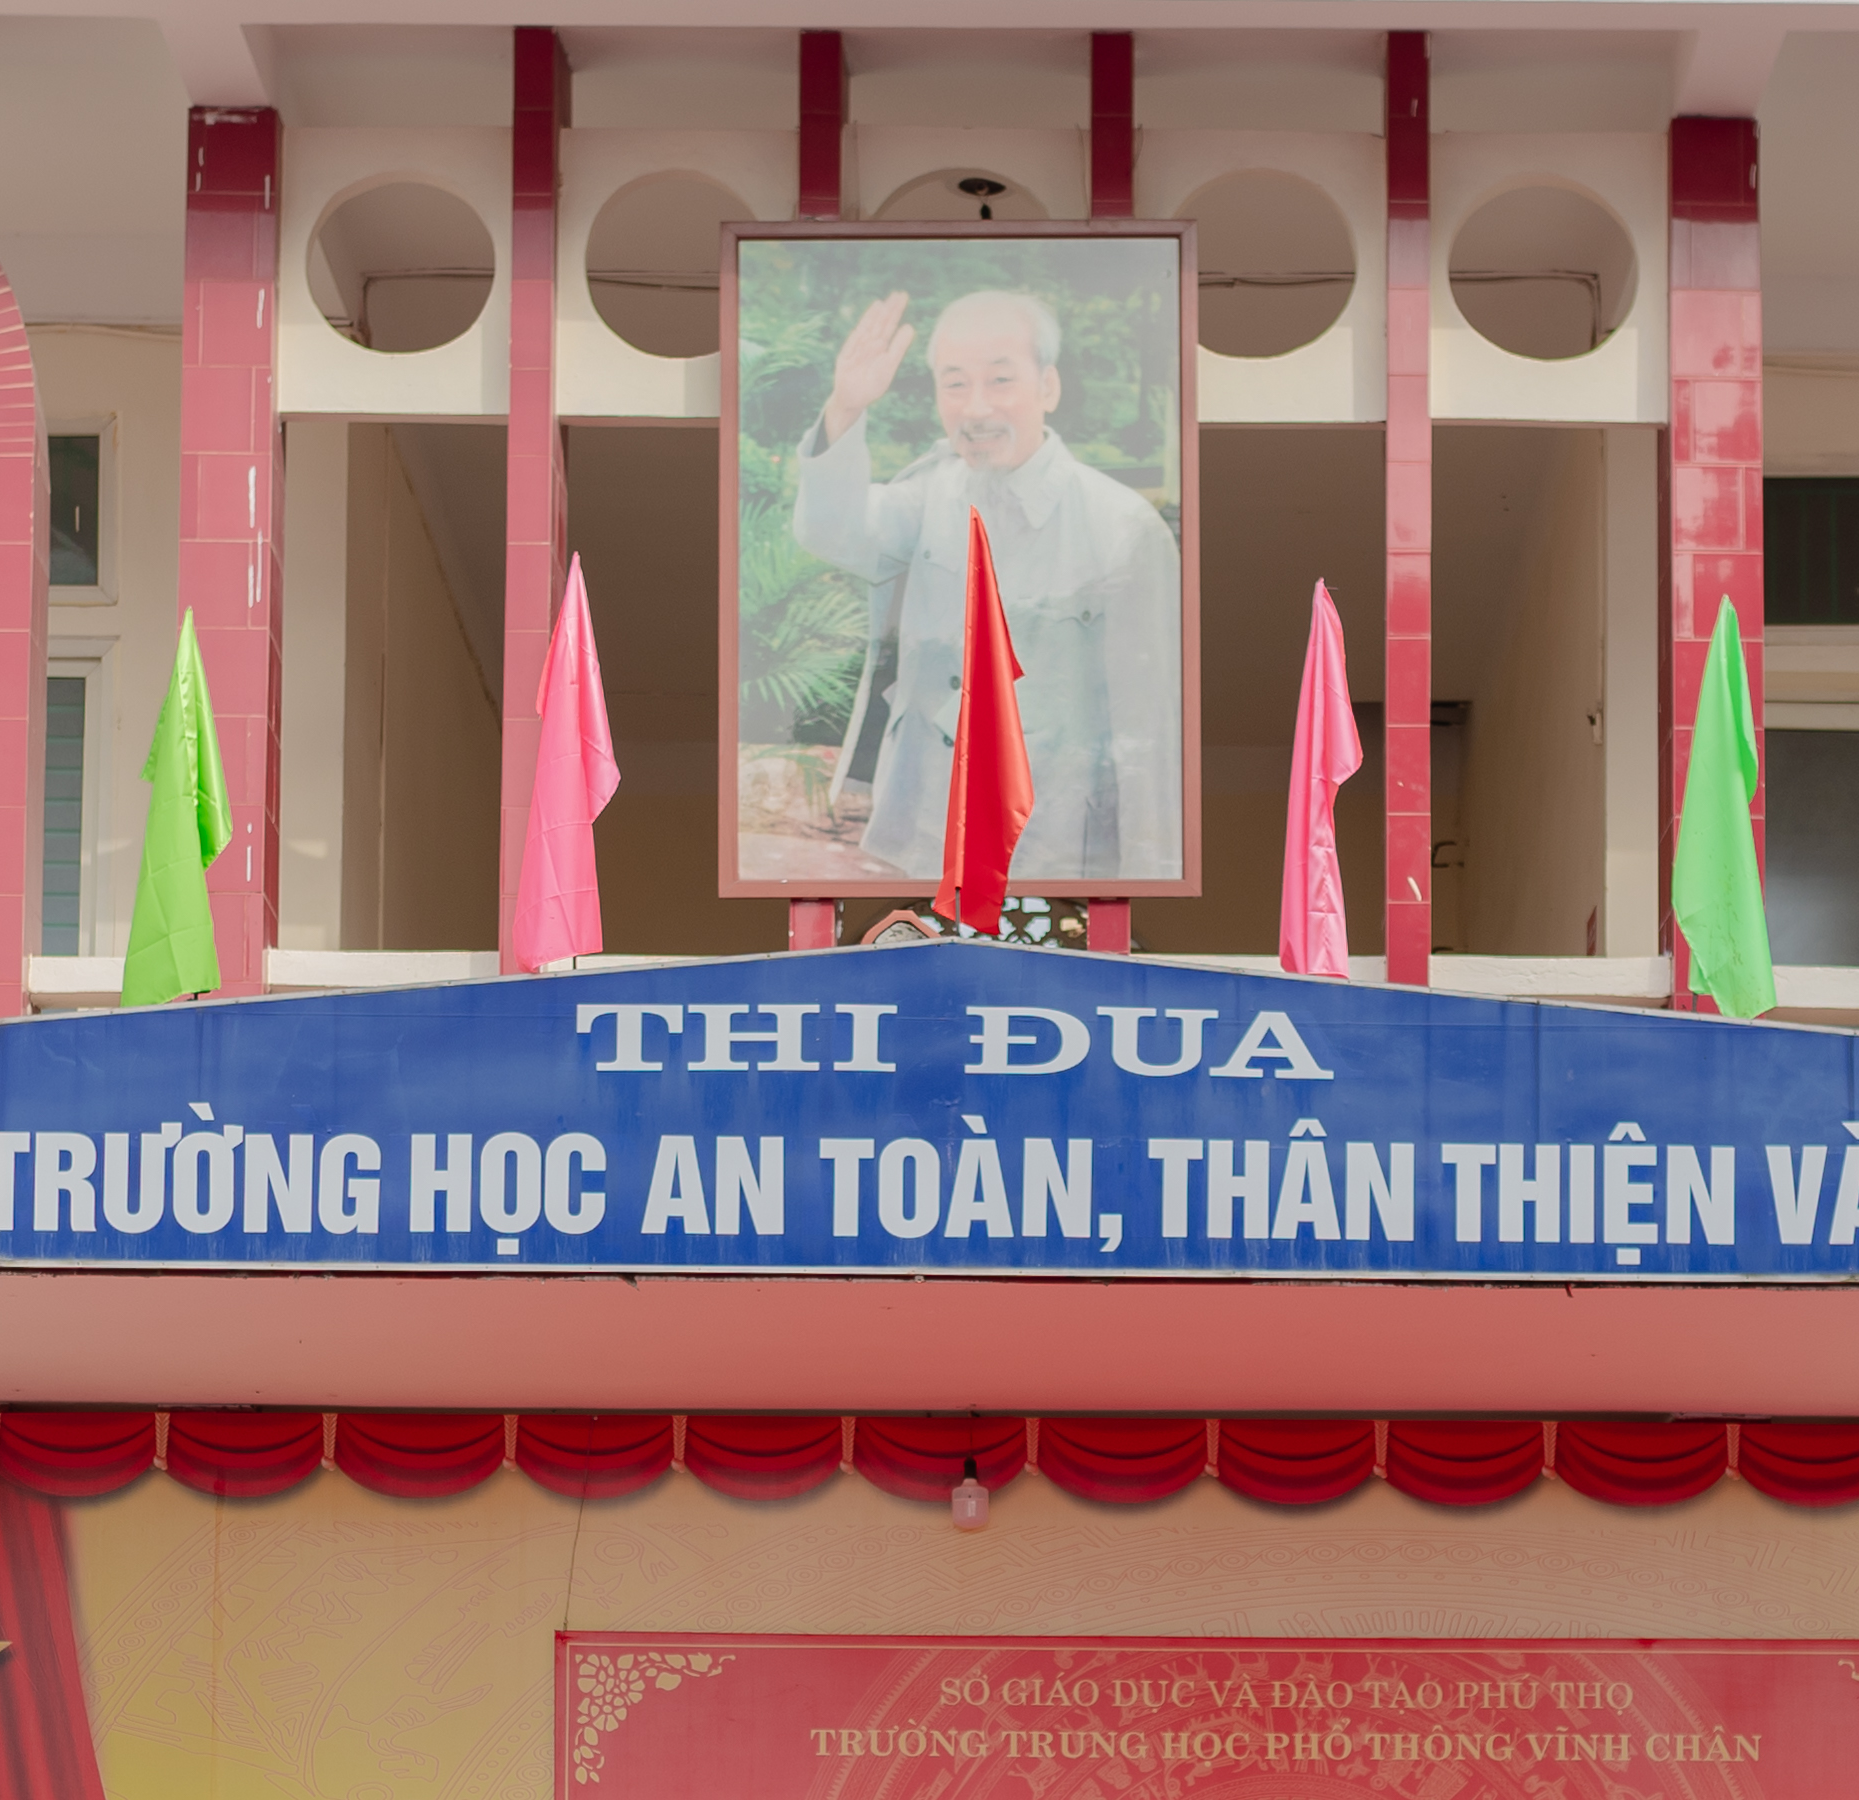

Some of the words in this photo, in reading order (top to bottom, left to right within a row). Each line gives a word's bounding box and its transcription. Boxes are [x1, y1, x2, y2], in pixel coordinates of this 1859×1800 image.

[576, 1004, 898, 1073] THI
[963, 1005, 1335, 1080] ĐUA
[410, 1131, 608, 1256] HỌC
[641, 1135, 785, 1237] AN
[819, 1114, 1124, 1254] TOÀN,
[1148, 1118, 1415, 1243] THÂN
[1441, 1121, 1736, 1265] THIỆN
[939, 1668, 991, 1707] SỞ
[1001, 1672, 1100, 1708] GIÁO
[1111, 1679, 1197, 1714] DỤC
[1207, 1673, 1260, 1709] VÀ
[1270, 1673, 1354, 1709] ĐÀO
[1364, 1681, 1443, 1715] TẠO
[1457, 1673, 1539, 1709] PHÚ
[1551, 1681, 1634, 1716] THỌ
[810, 1717, 990, 1759] TRƯỜNG
[1002, 1731, 1149, 1760] TRUNG
[1161, 1732, 1250, 1768] HỌC
[1263, 1717, 1353, 1761] PHỔ
[1365, 1724, 1513, 1762] THÔNG
[1526, 1726, 1632, 1762] VĨNH
[1645, 1724, 1762, 1762] CHÂN
